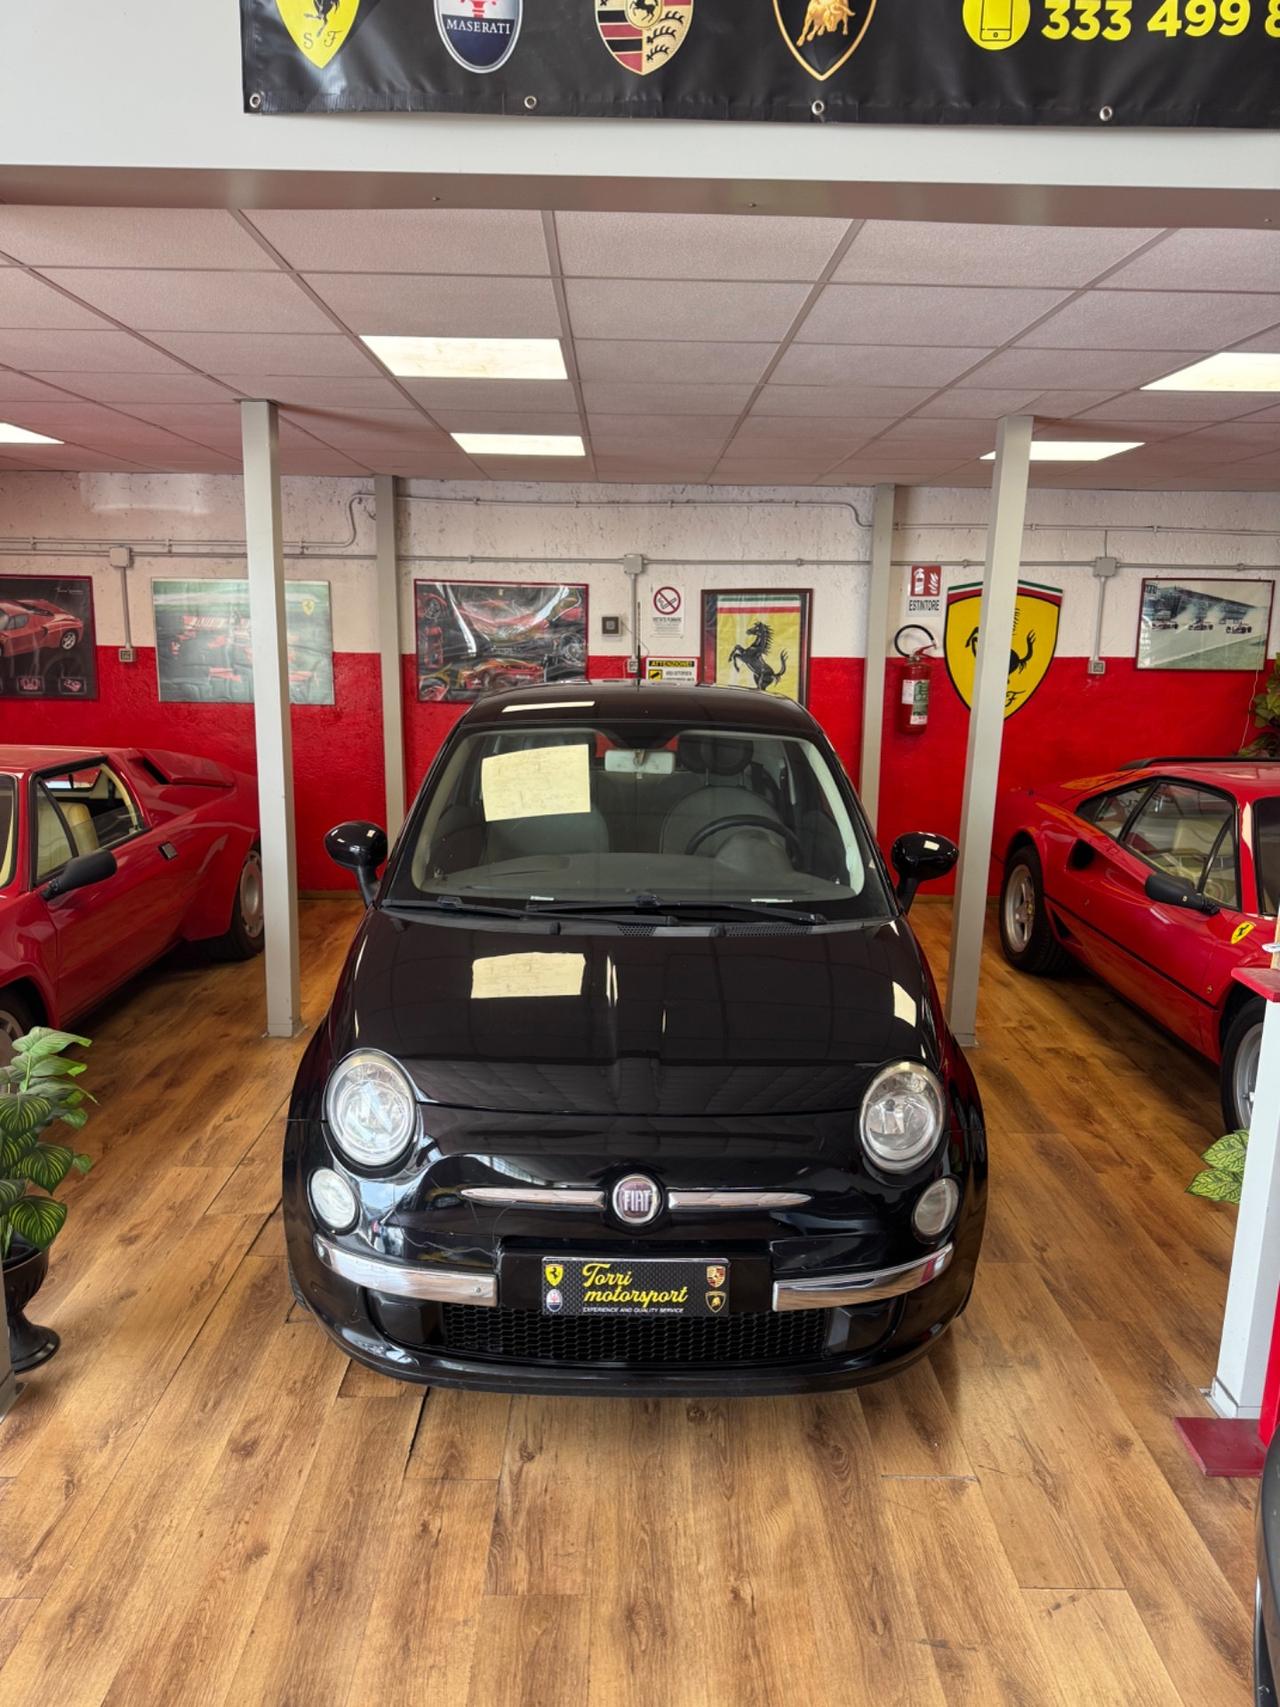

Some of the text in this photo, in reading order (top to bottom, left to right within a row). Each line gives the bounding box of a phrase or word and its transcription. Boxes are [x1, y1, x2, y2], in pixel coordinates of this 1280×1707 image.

[446, 18, 511, 35] MASERATI
[1041, 0, 1132, 41] 333
[1147, 0, 1250, 37] 499
[909, 599, 940, 611] ESTINTORE
[623, 1189, 651, 1212] FIAT
[582, 1263, 632, 1287] Torri
[583, 1285, 688, 1308] motorsport
